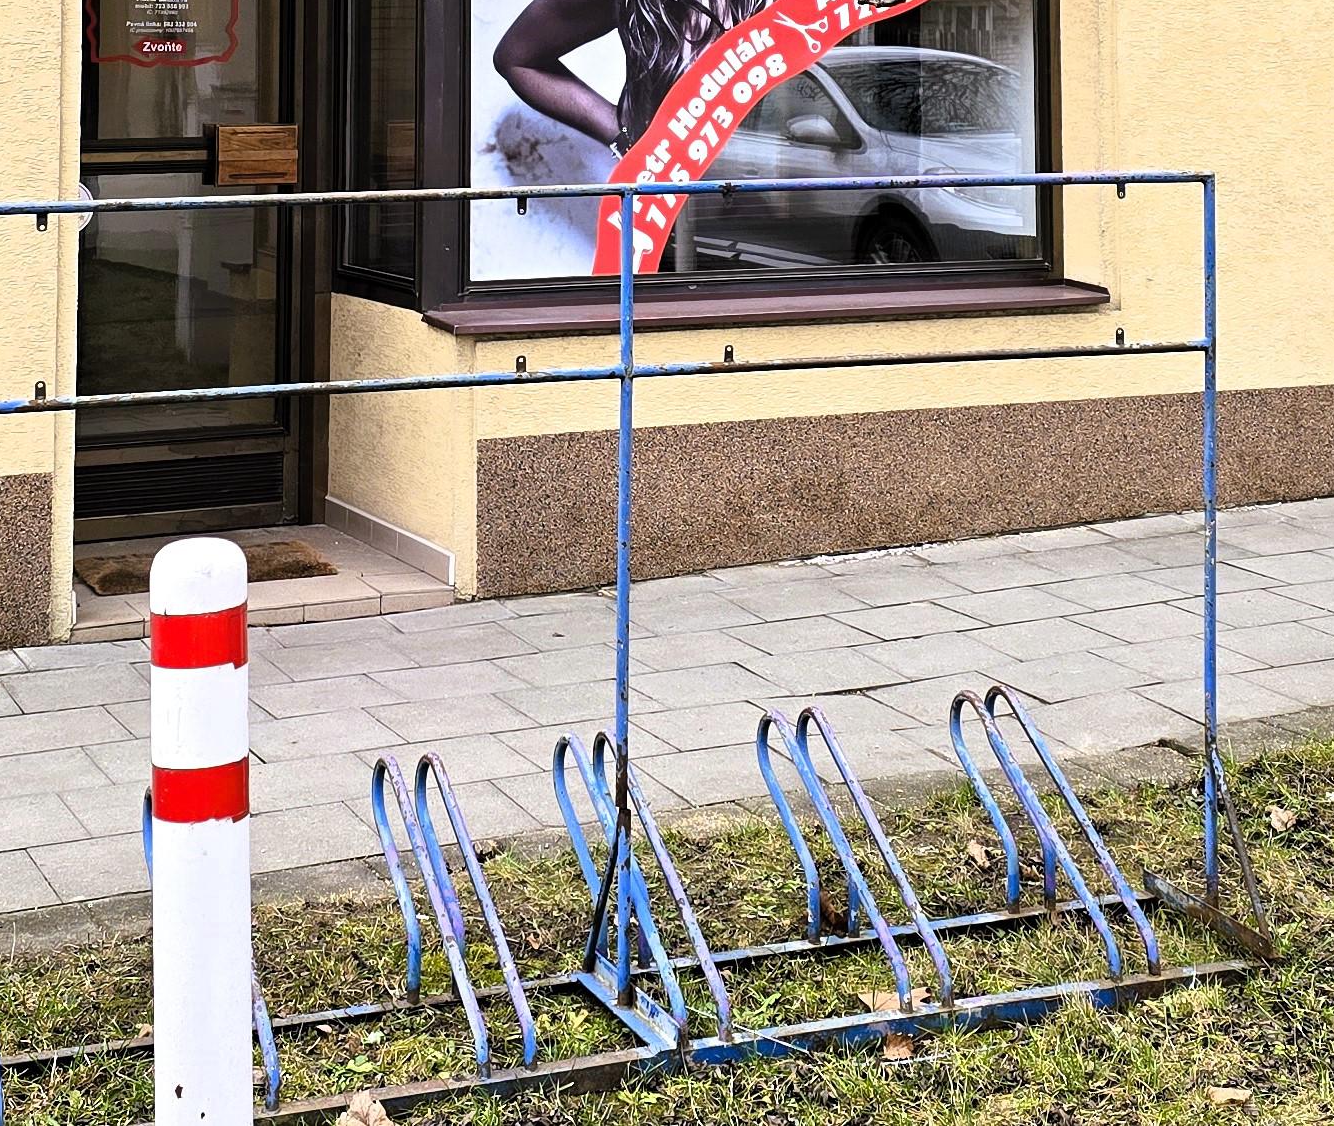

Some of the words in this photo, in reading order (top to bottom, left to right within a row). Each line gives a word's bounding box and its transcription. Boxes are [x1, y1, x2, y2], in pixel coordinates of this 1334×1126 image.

[142, 41, 183, 52] Zvoňte
[633, 139, 672, 213] etr
[667, 28, 775, 141] Hodulák
[687, 105, 734, 166] 973
[732, 53, 788, 104] 098
